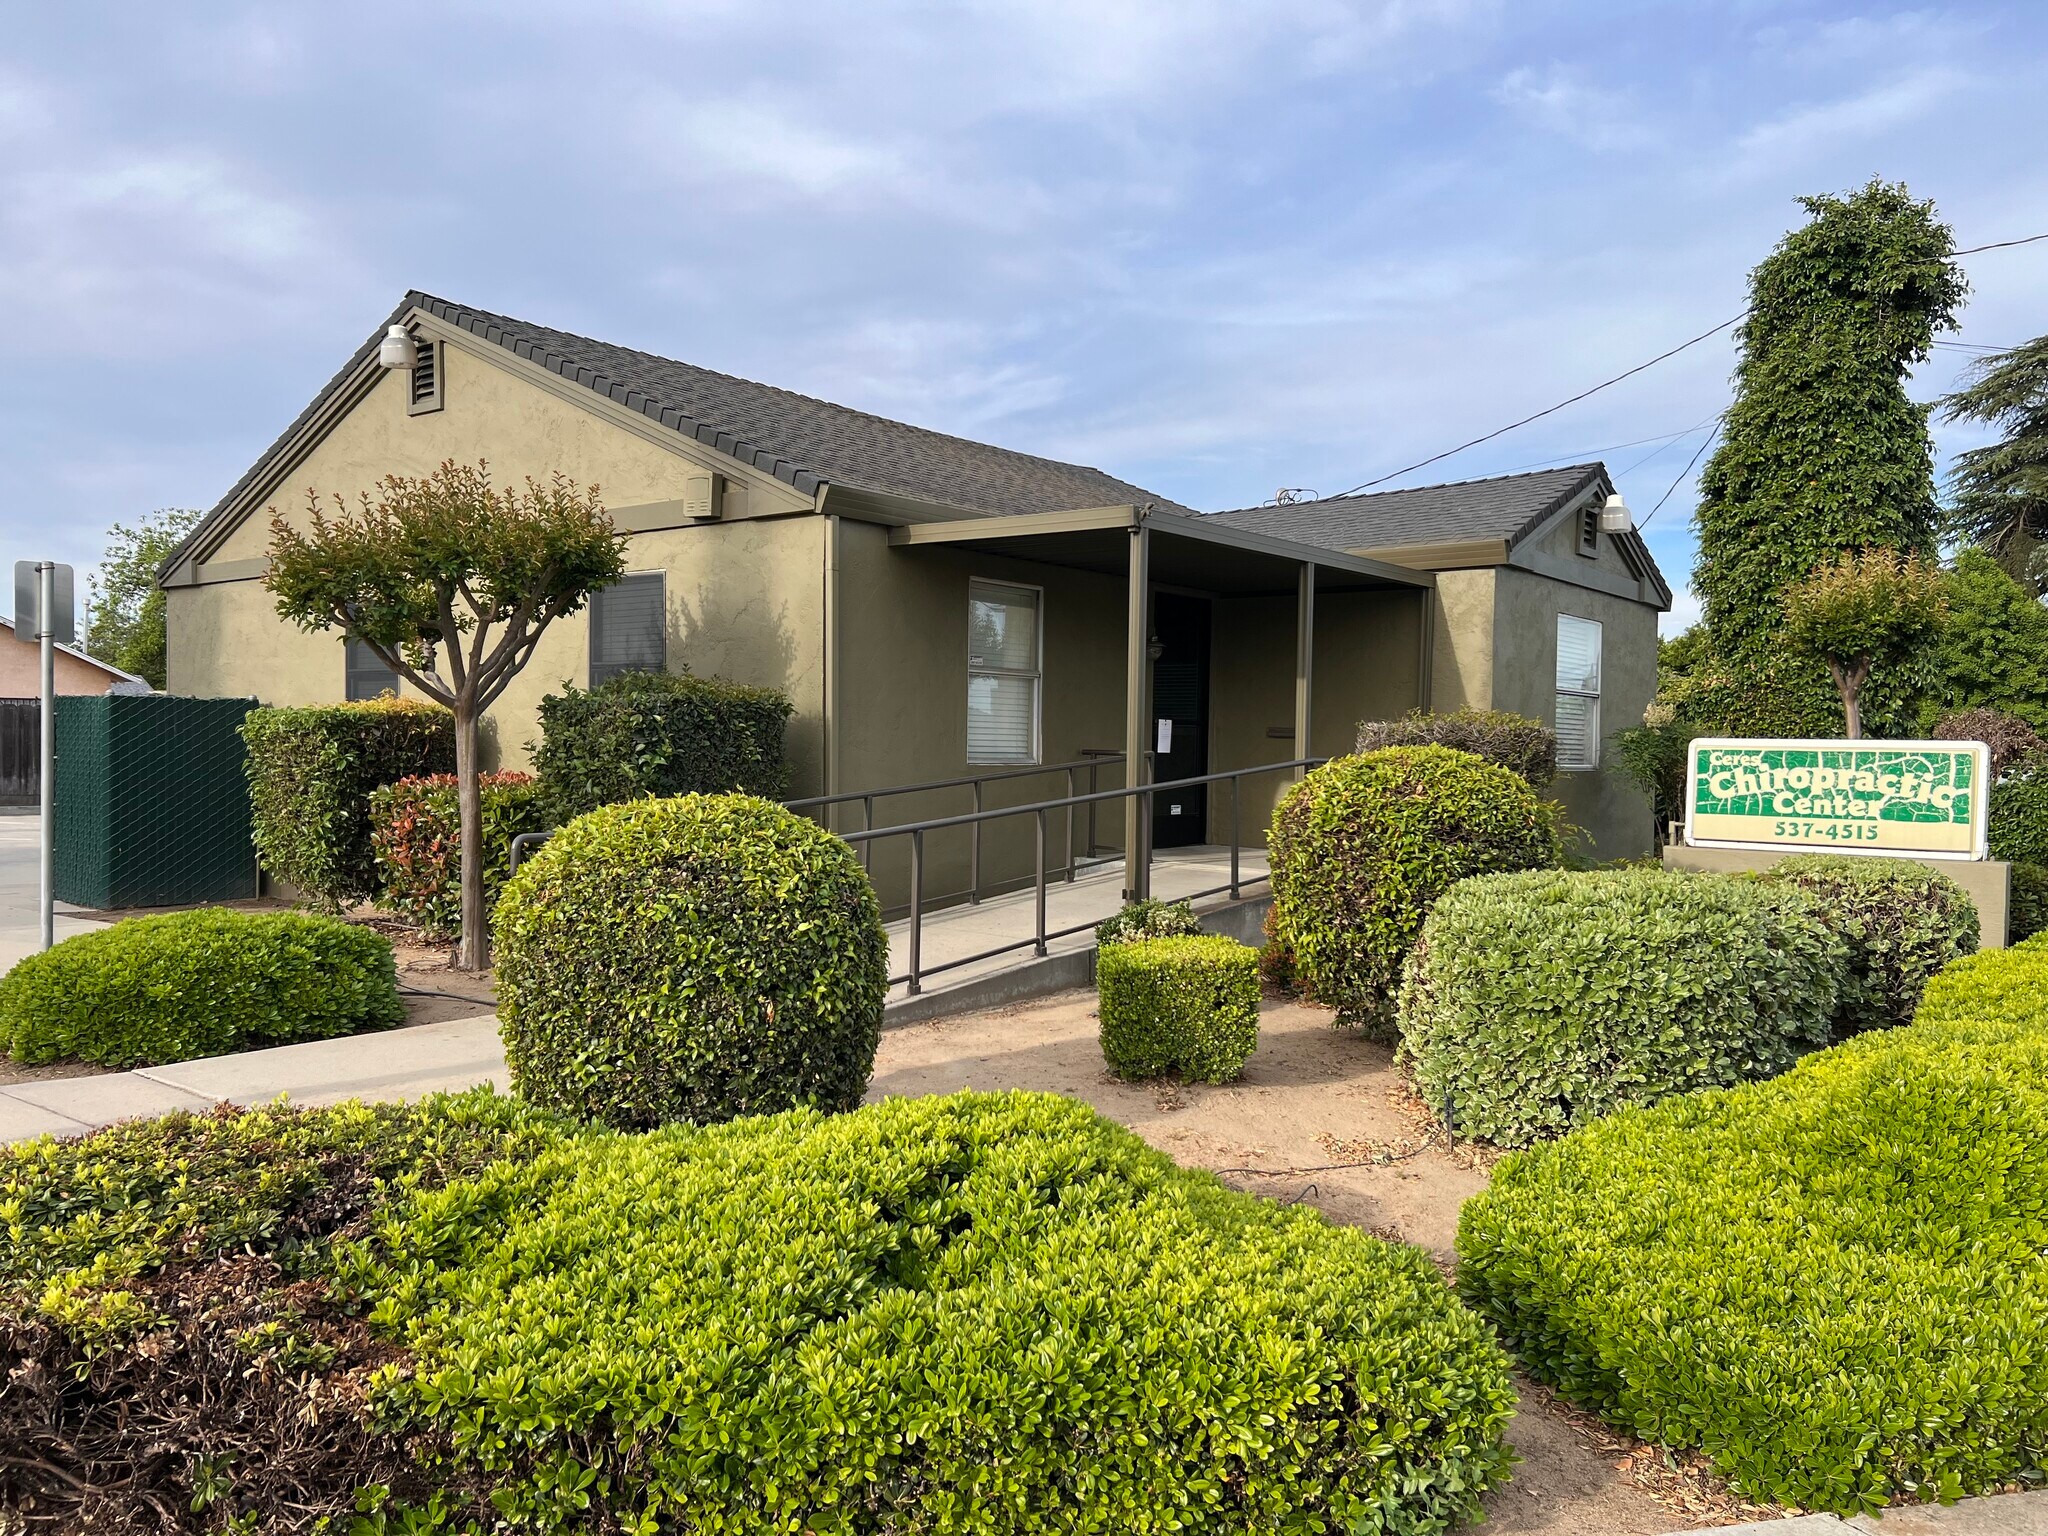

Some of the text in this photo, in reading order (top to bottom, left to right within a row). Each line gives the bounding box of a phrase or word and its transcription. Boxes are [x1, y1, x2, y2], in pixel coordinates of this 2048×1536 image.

[1710, 751, 1761, 766] Ceres
[1710, 764, 1957, 808] Chiropractic
[1773, 791, 1883, 816] Center
[1774, 822, 1879, 840] 537-4515
